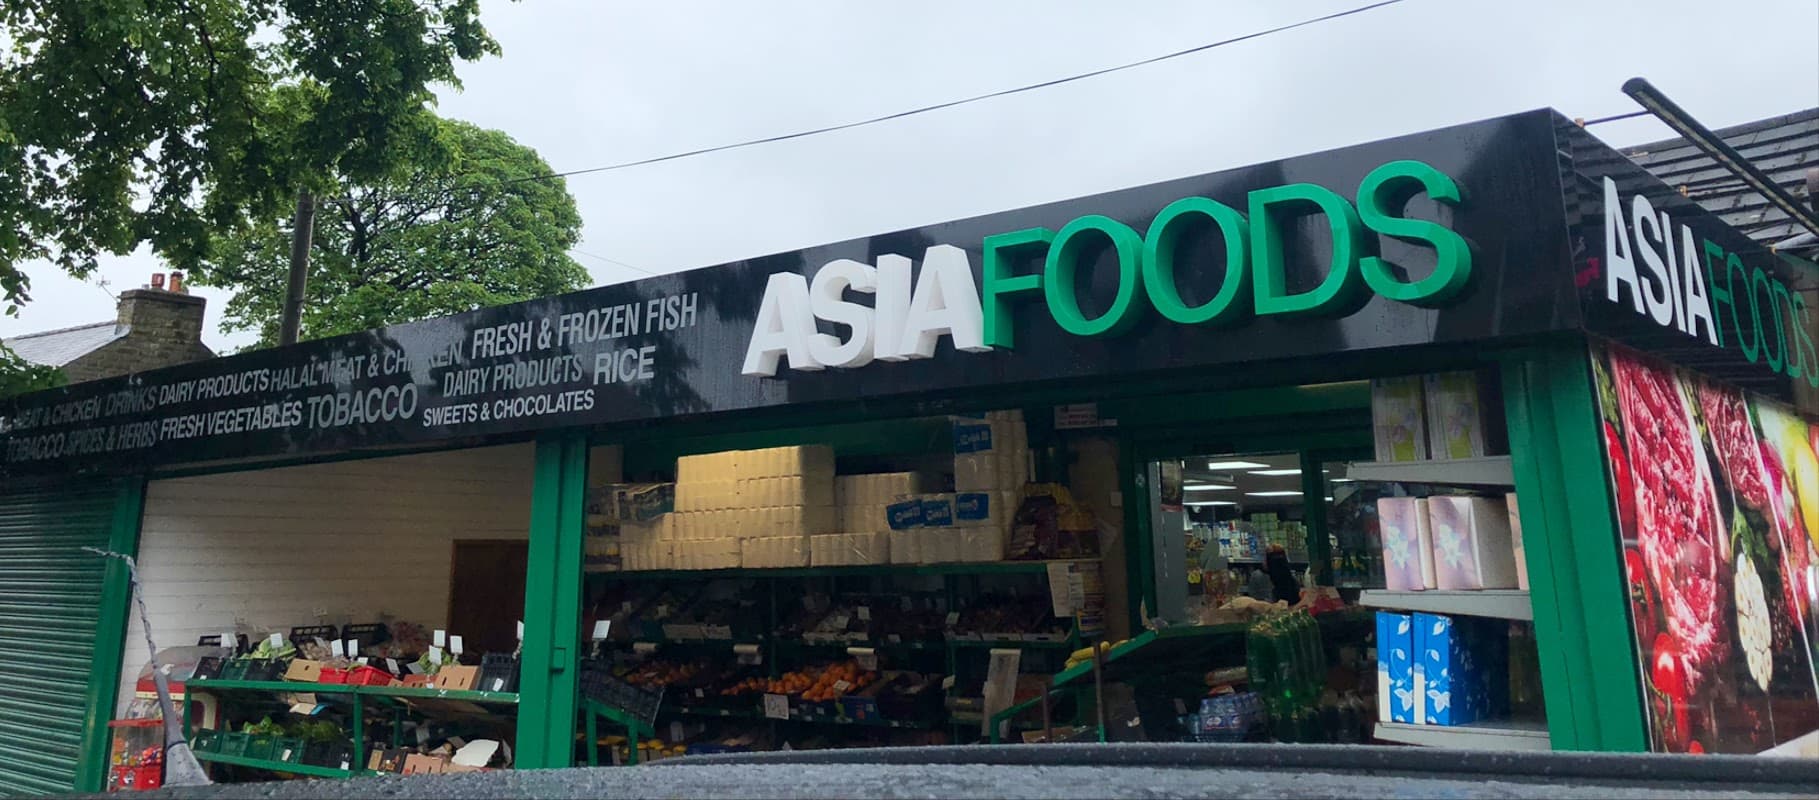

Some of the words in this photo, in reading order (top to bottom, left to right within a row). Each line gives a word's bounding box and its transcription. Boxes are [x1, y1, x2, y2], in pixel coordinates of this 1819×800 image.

[52, 398, 102, 424] CHICKEN
[105, 386, 157, 416] DRINKS
[159, 380, 197, 405] DAIRY
[197, 368, 269, 400] PRODUCTS
[270, 363, 318, 392] HALAL
[321, 355, 365, 384] MEAT
[367, 353, 379, 378] &
[472, 321, 533, 360] FRESH
[537, 318, 552, 350] &
[558, 303, 640, 347] FROZEN
[646, 292, 698, 334] FISH
[443, 366, 490, 398] DAIRY
[493, 354, 583, 392] PRODUCTS
[593, 345, 656, 385] RICE
[5, 433, 65, 463] TOBACCO
[65, 428, 105, 456] SPICES
[116, 420, 158, 450] HERBS
[160, 413, 206, 440] FRESH
[208, 400, 302, 435] VEGETABLES
[307, 382, 418, 429] TOBACCO
[423, 402, 478, 427] SWEETS
[480, 403, 490, 421] &
[494, 389, 595, 419] CHOCOLATES
